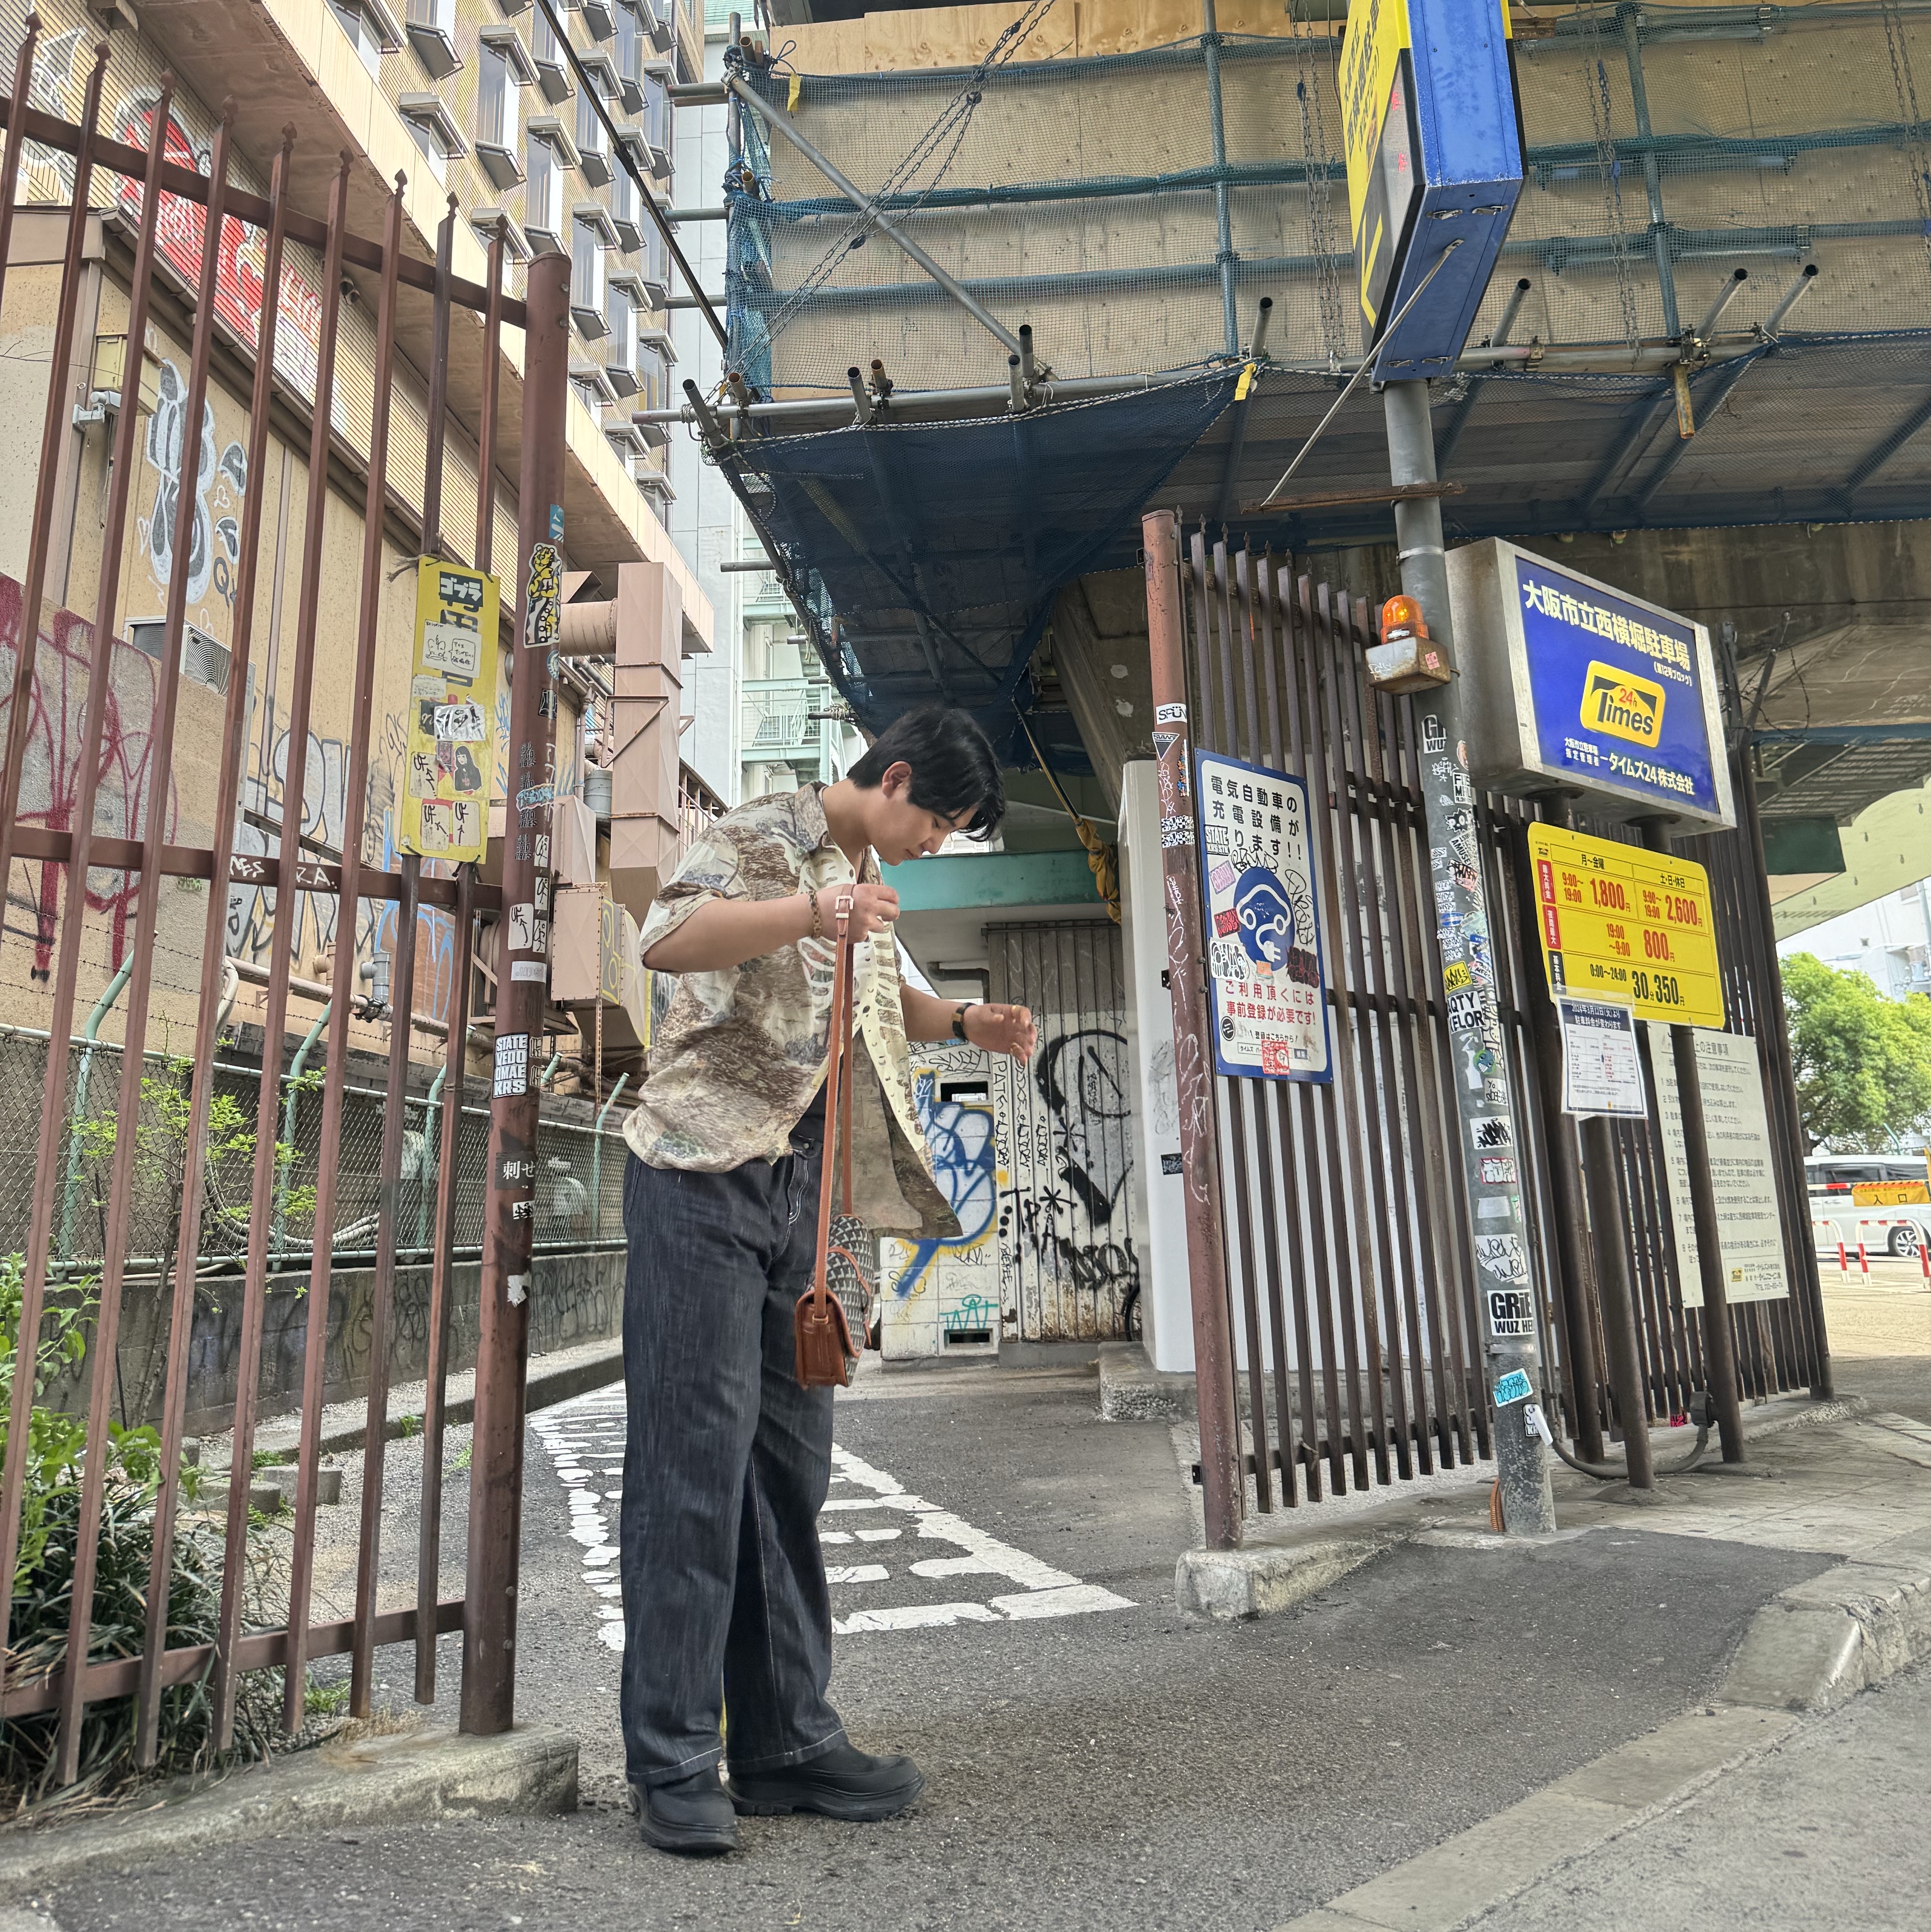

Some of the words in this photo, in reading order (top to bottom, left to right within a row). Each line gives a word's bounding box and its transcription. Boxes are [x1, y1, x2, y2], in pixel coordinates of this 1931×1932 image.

[1523, 579, 1690, 671] 大阪市立西横堀駐車場
[1594, 688, 1654, 735] Times
[1609, 752, 1696, 795] タイムズ24株式会社
[1211, 775, 1297, 813] 電気自動車の
[1212, 800, 1299, 836] 充電設備が
[1234, 829, 1301, 860] ります!!
[1564, 887, 1582, 903] 19:00
[1590, 877, 1631, 913] 1,800円
[1645, 904, 1660, 920] 19:00
[1665, 895, 1703, 928] 2,600円
[1606, 923, 1625, 940] 19:00
[1643, 929, 1675, 963] 800円
[1225, 979, 1315, 1005] ご利用頂くには
[1226, 1000, 1316, 1025] 事前登録が必要です!
[1574, 1014, 1621, 1030] 駐車料金が変わります
[495, 1034, 528, 1052] STATE
[493, 1078, 527, 1098] KRS
